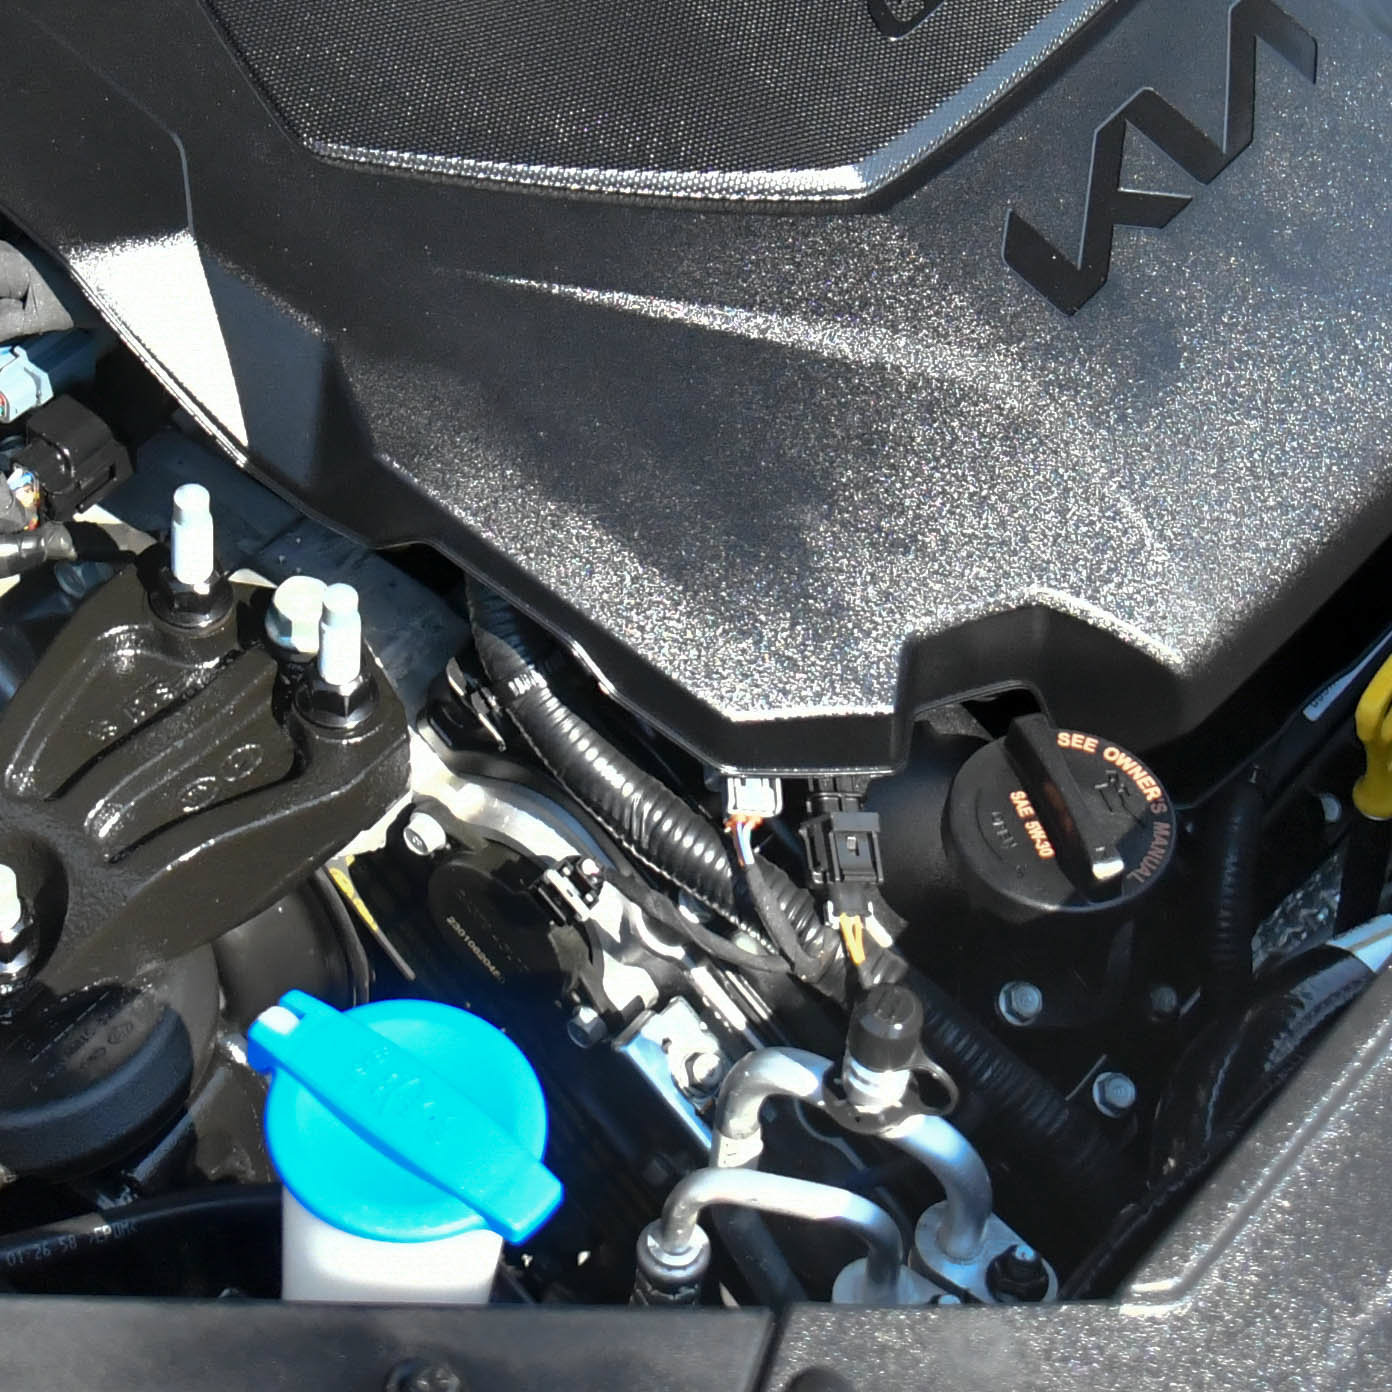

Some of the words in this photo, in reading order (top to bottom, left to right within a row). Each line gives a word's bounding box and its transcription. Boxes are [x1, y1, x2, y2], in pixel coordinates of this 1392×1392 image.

[1056, 731, 1099, 754] SEE
[1103, 746, 1168, 815] OWNER'S
[1009, 790, 1036, 819] SAE
[1024, 819, 1056, 860] 5W-30
[1125, 820, 1171, 884] MANUAL
